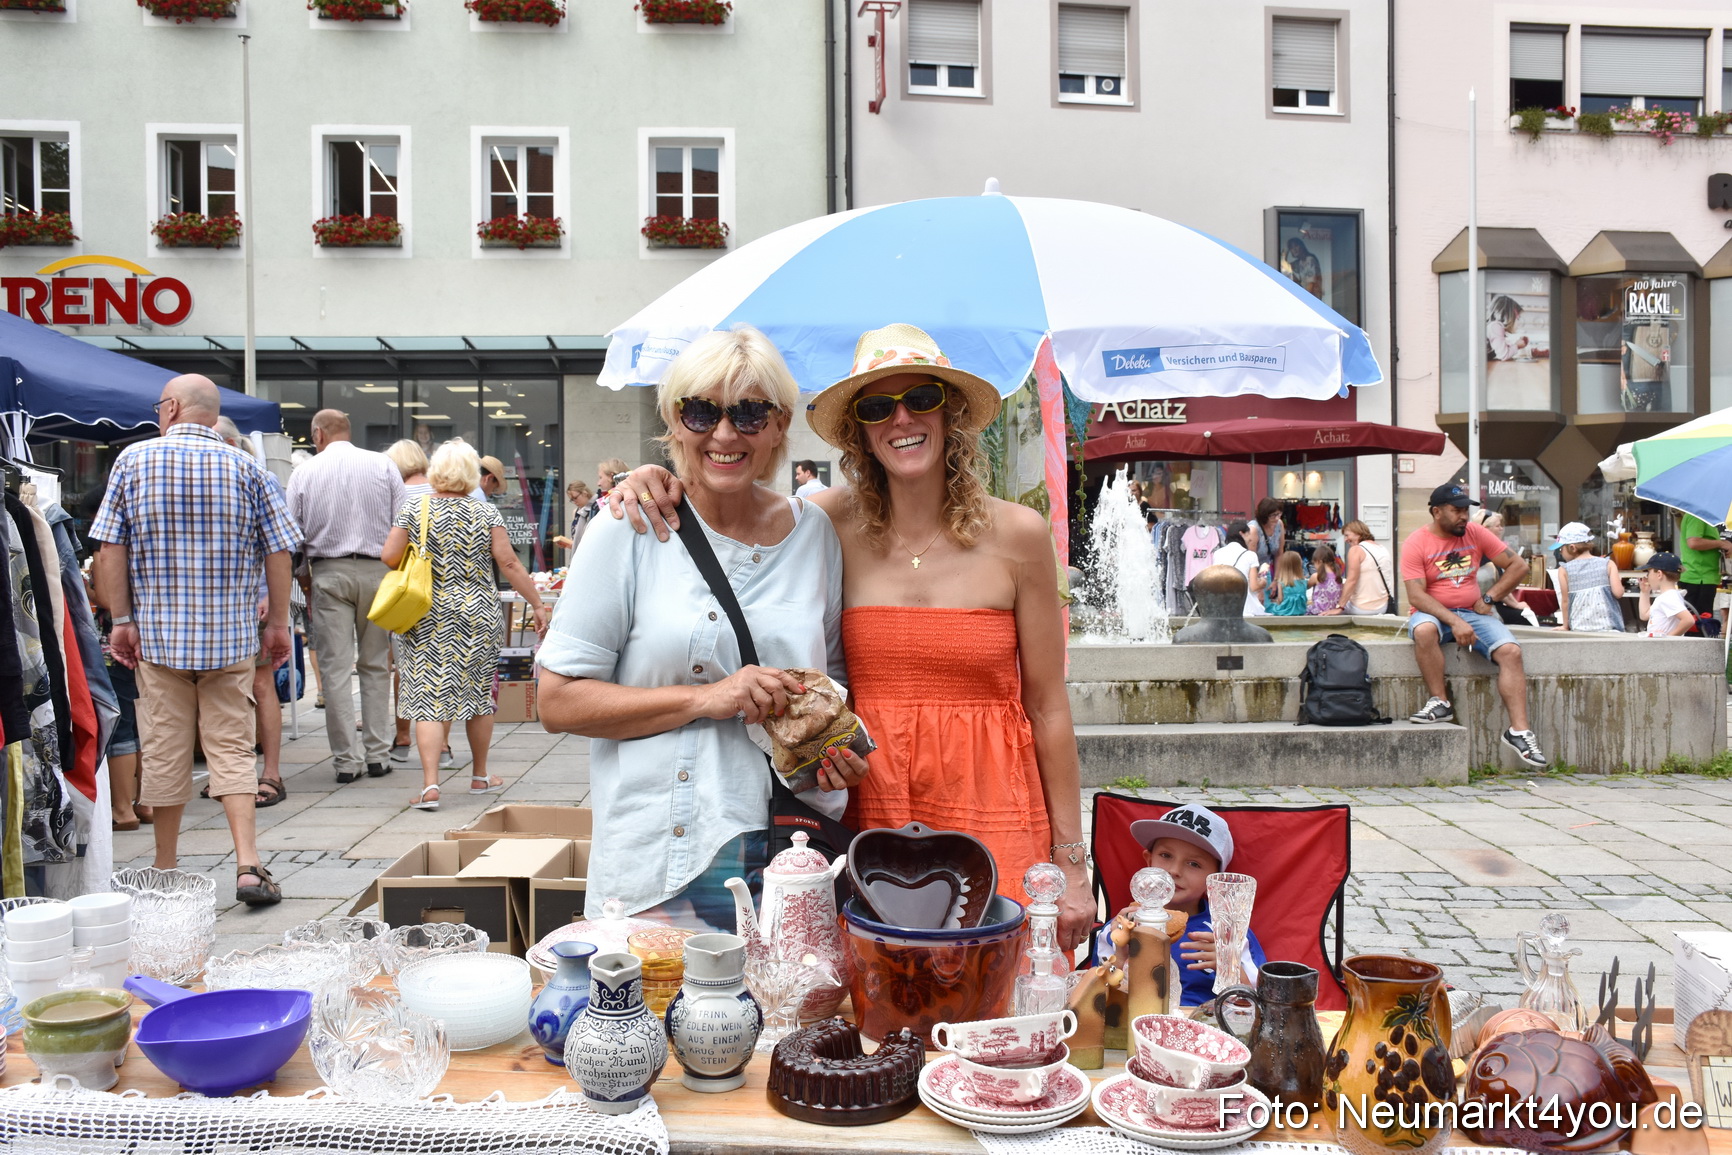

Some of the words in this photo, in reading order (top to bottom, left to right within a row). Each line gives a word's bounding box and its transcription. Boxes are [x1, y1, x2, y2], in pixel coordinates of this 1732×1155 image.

[1633, 280, 1649, 291] 100
[1650, 279, 1677, 291] Jahre
[1, 277, 192, 326] RENO
[1629, 292, 1670, 314] RACKL
[1110, 354, 1152, 371] Debeka
[1166, 355, 1216, 366] Versichern
[1218, 352, 1237, 363] und
[1240, 352, 1278, 365] Bausparen
[1097, 398, 1188, 422] Achatz
[1124, 434, 1148, 450] Achatz
[1312, 429, 1352, 445] Achatz
[1488, 480, 1516, 495] RACKL
[506, 522, 539, 530] ULSTART
[508, 530, 533, 538] STENS
[794, 817, 819, 827] SPORTS
[698, 1009, 728, 1019] TRINK
[721, 1022, 742, 1032] WEIN
[688, 1035, 705, 1044] AUS
[712, 1035, 740, 1045] EINEM
[688, 1047, 715, 1056] KRUG
[721, 1046, 738, 1055] VON
[700, 1057, 728, 1065] STEIN
